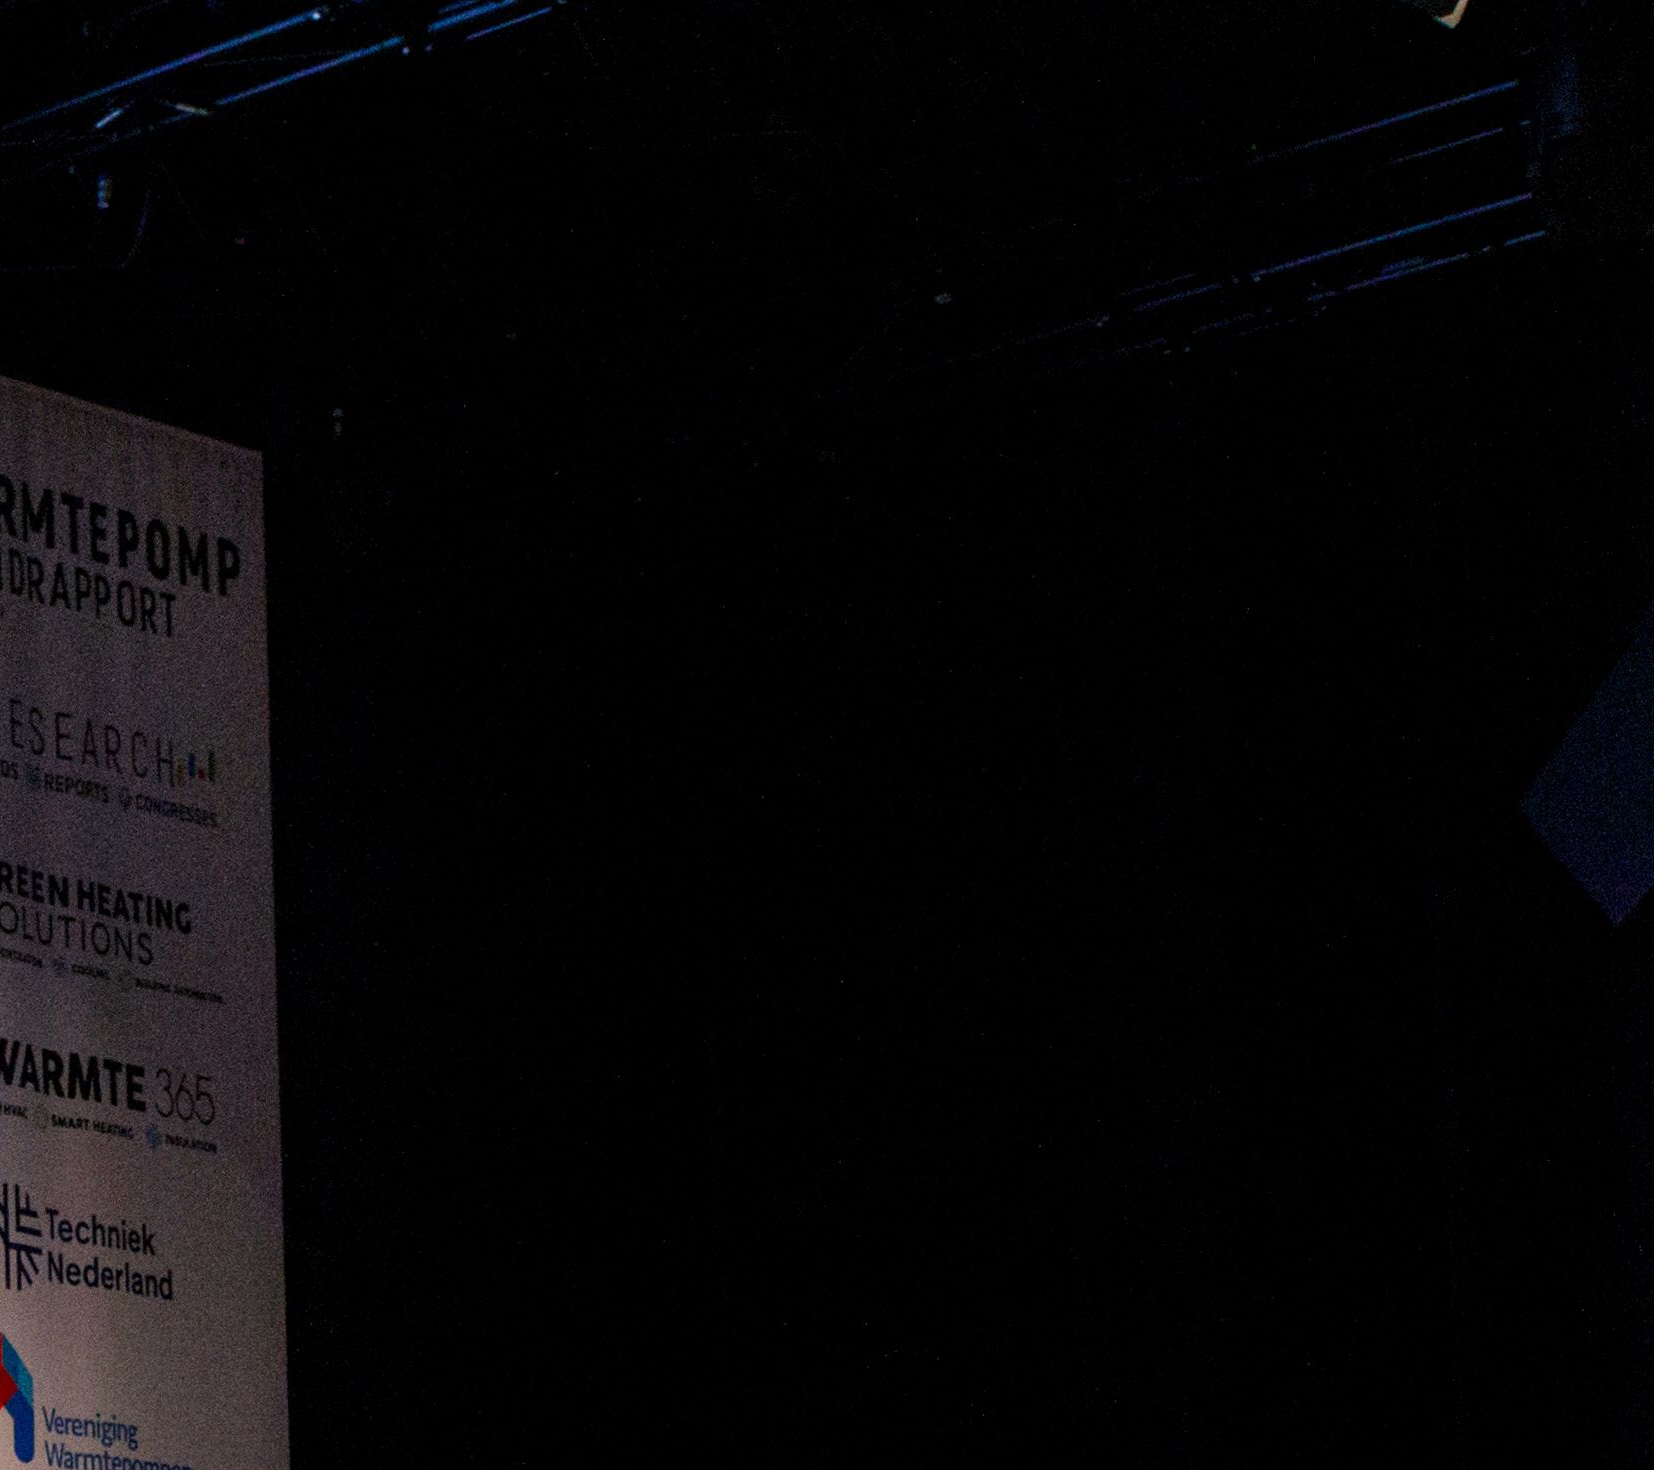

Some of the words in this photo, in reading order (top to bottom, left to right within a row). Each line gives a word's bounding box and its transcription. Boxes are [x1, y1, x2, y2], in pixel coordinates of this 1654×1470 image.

[44, 773, 109, 803] REPORTS
[77, 880, 191, 934] HEATING
[155, 1068, 215, 1126] 365
[51, 1114, 90, 1131] SMART
[46, 1208, 156, 1256] Techniek
[47, 1250, 173, 1300] Nederland
[42, 1406, 138, 1450] Vereniging
